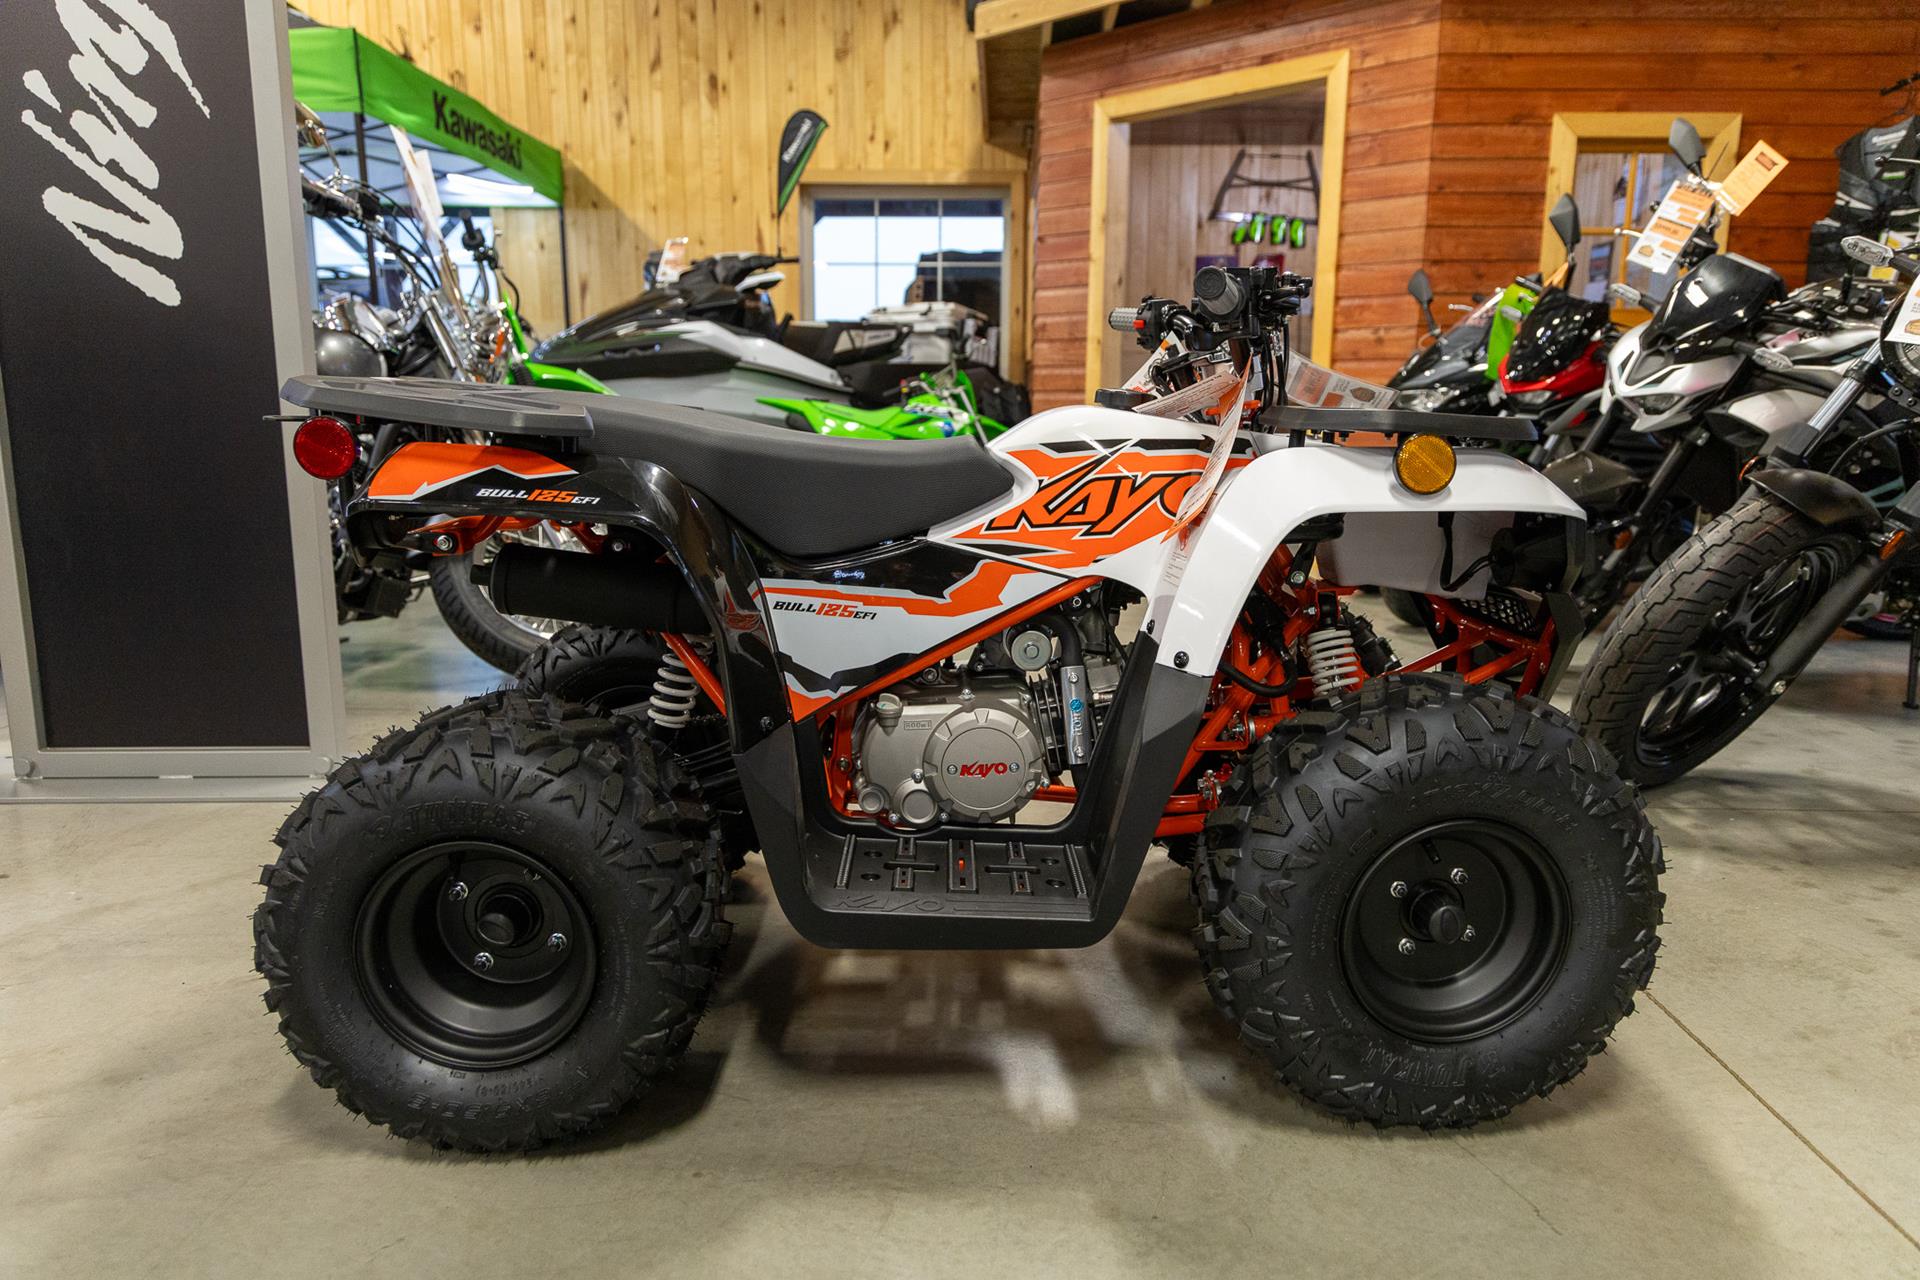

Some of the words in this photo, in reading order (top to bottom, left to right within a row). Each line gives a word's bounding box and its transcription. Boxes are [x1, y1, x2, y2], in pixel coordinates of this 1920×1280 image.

[432, 89, 522, 170] Kawasaki
[960, 760, 1008, 778] KAYO
[830, 894, 945, 913] KAYO
